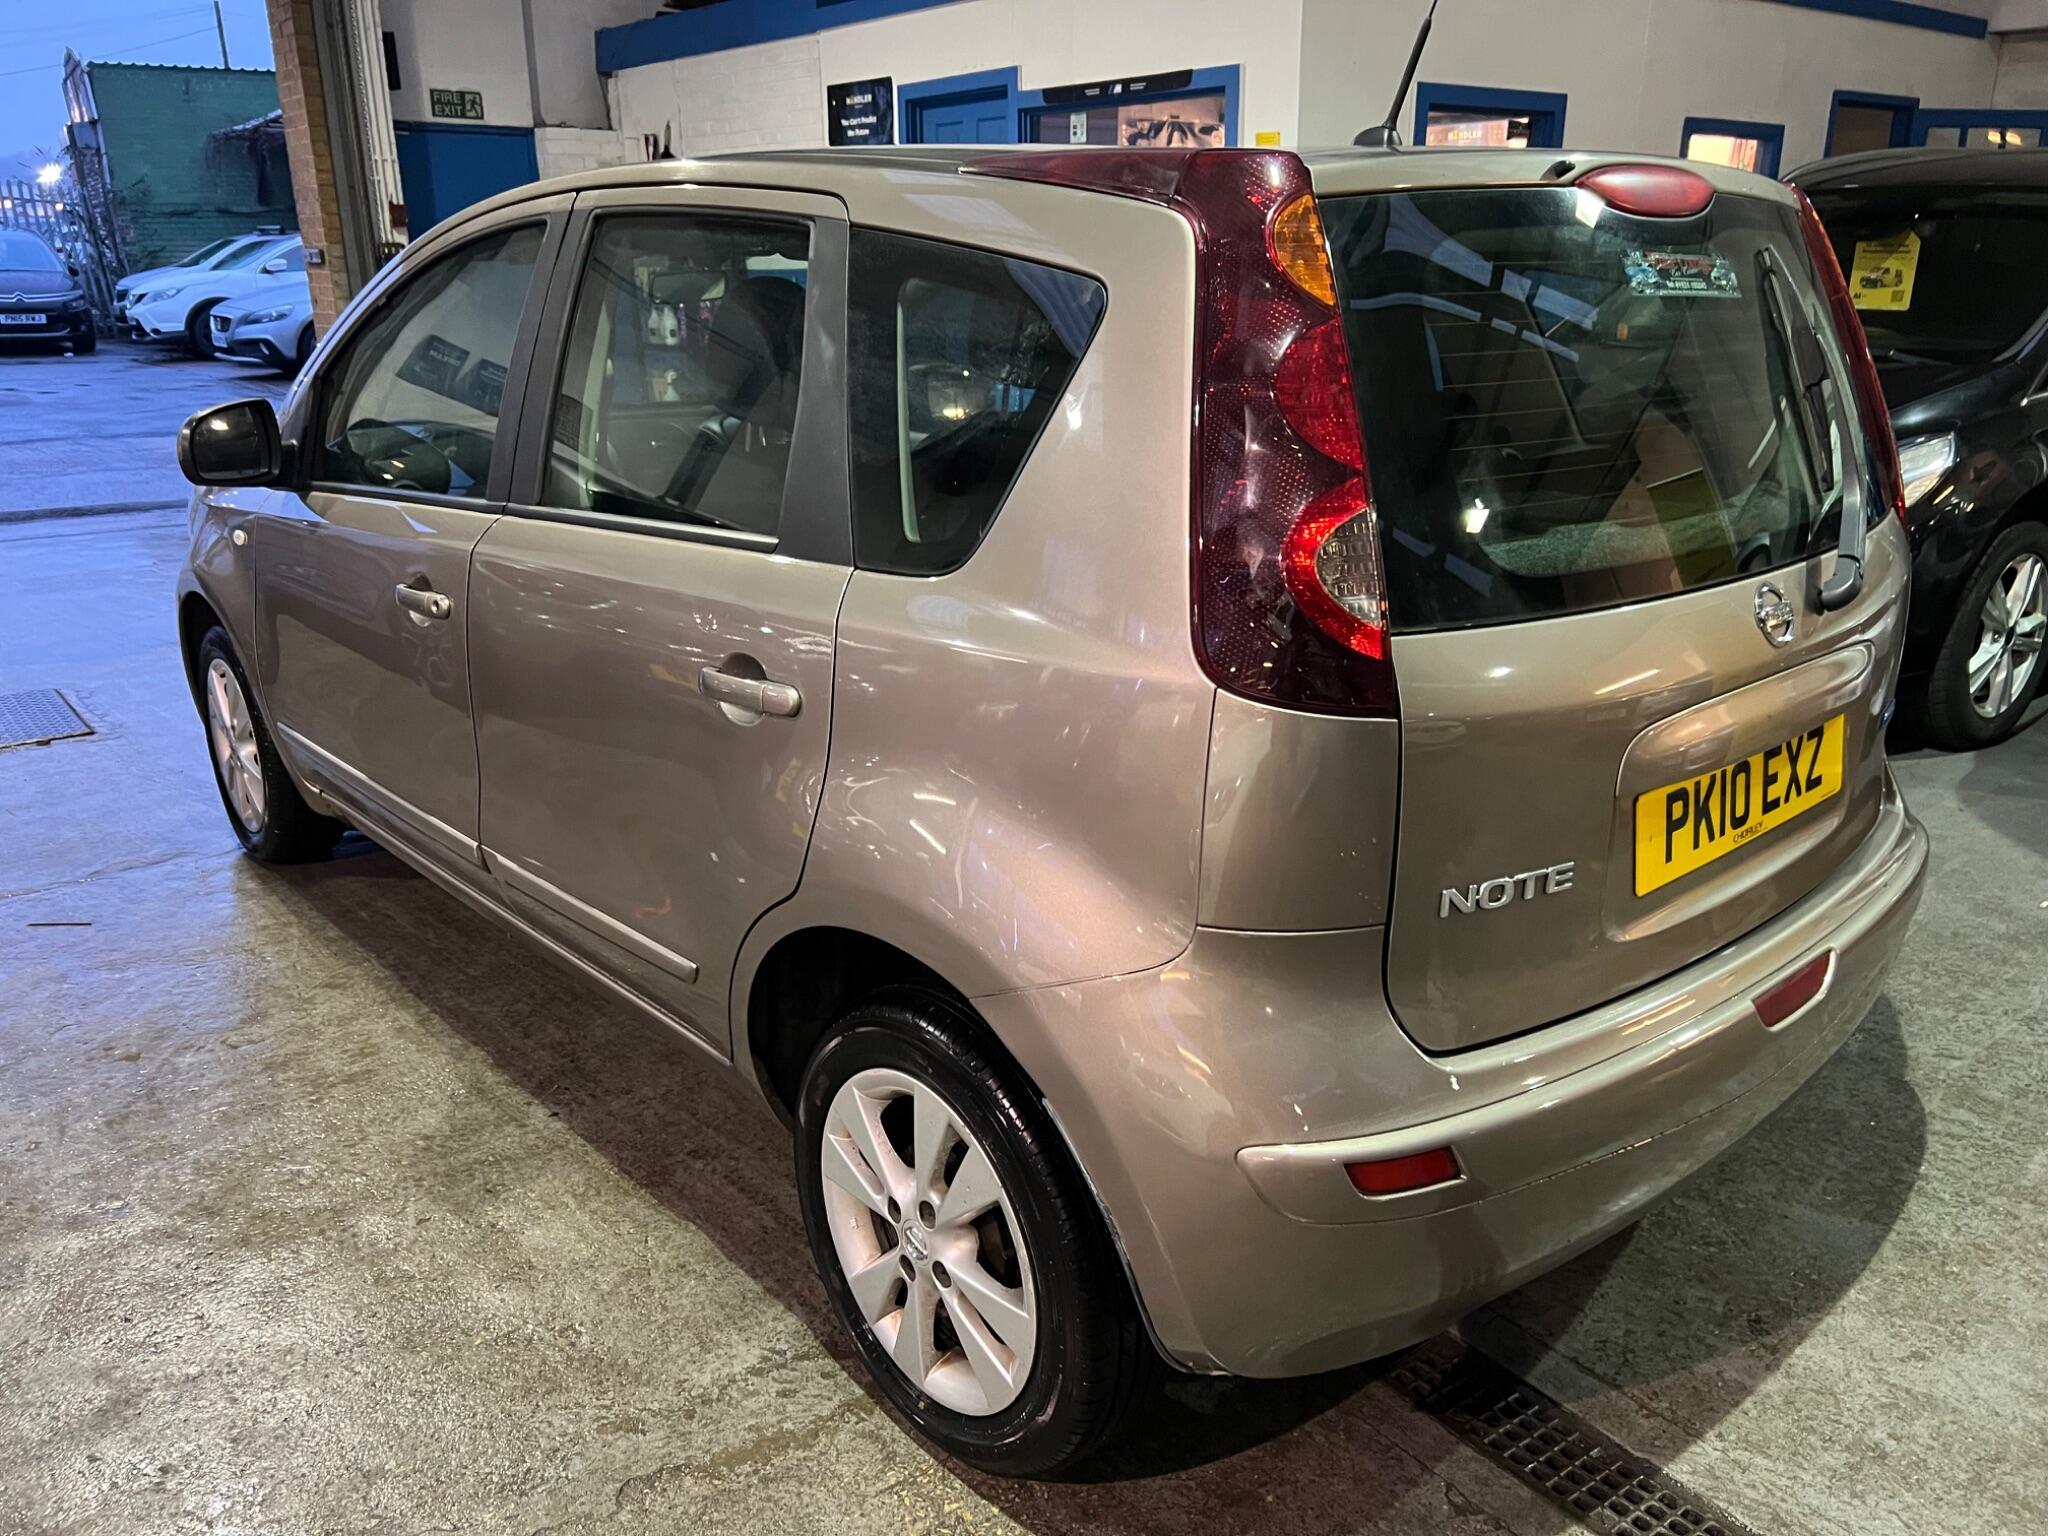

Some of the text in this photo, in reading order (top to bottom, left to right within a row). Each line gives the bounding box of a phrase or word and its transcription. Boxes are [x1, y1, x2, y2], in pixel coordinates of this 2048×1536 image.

[433, 91, 462, 103] FIRE
[434, 104, 463, 116] EXIT
[1665, 725, 1825, 864] PK10 EXZ
[1732, 820, 1763, 844] CHORLEY
[1440, 861, 1576, 918] NOTE
